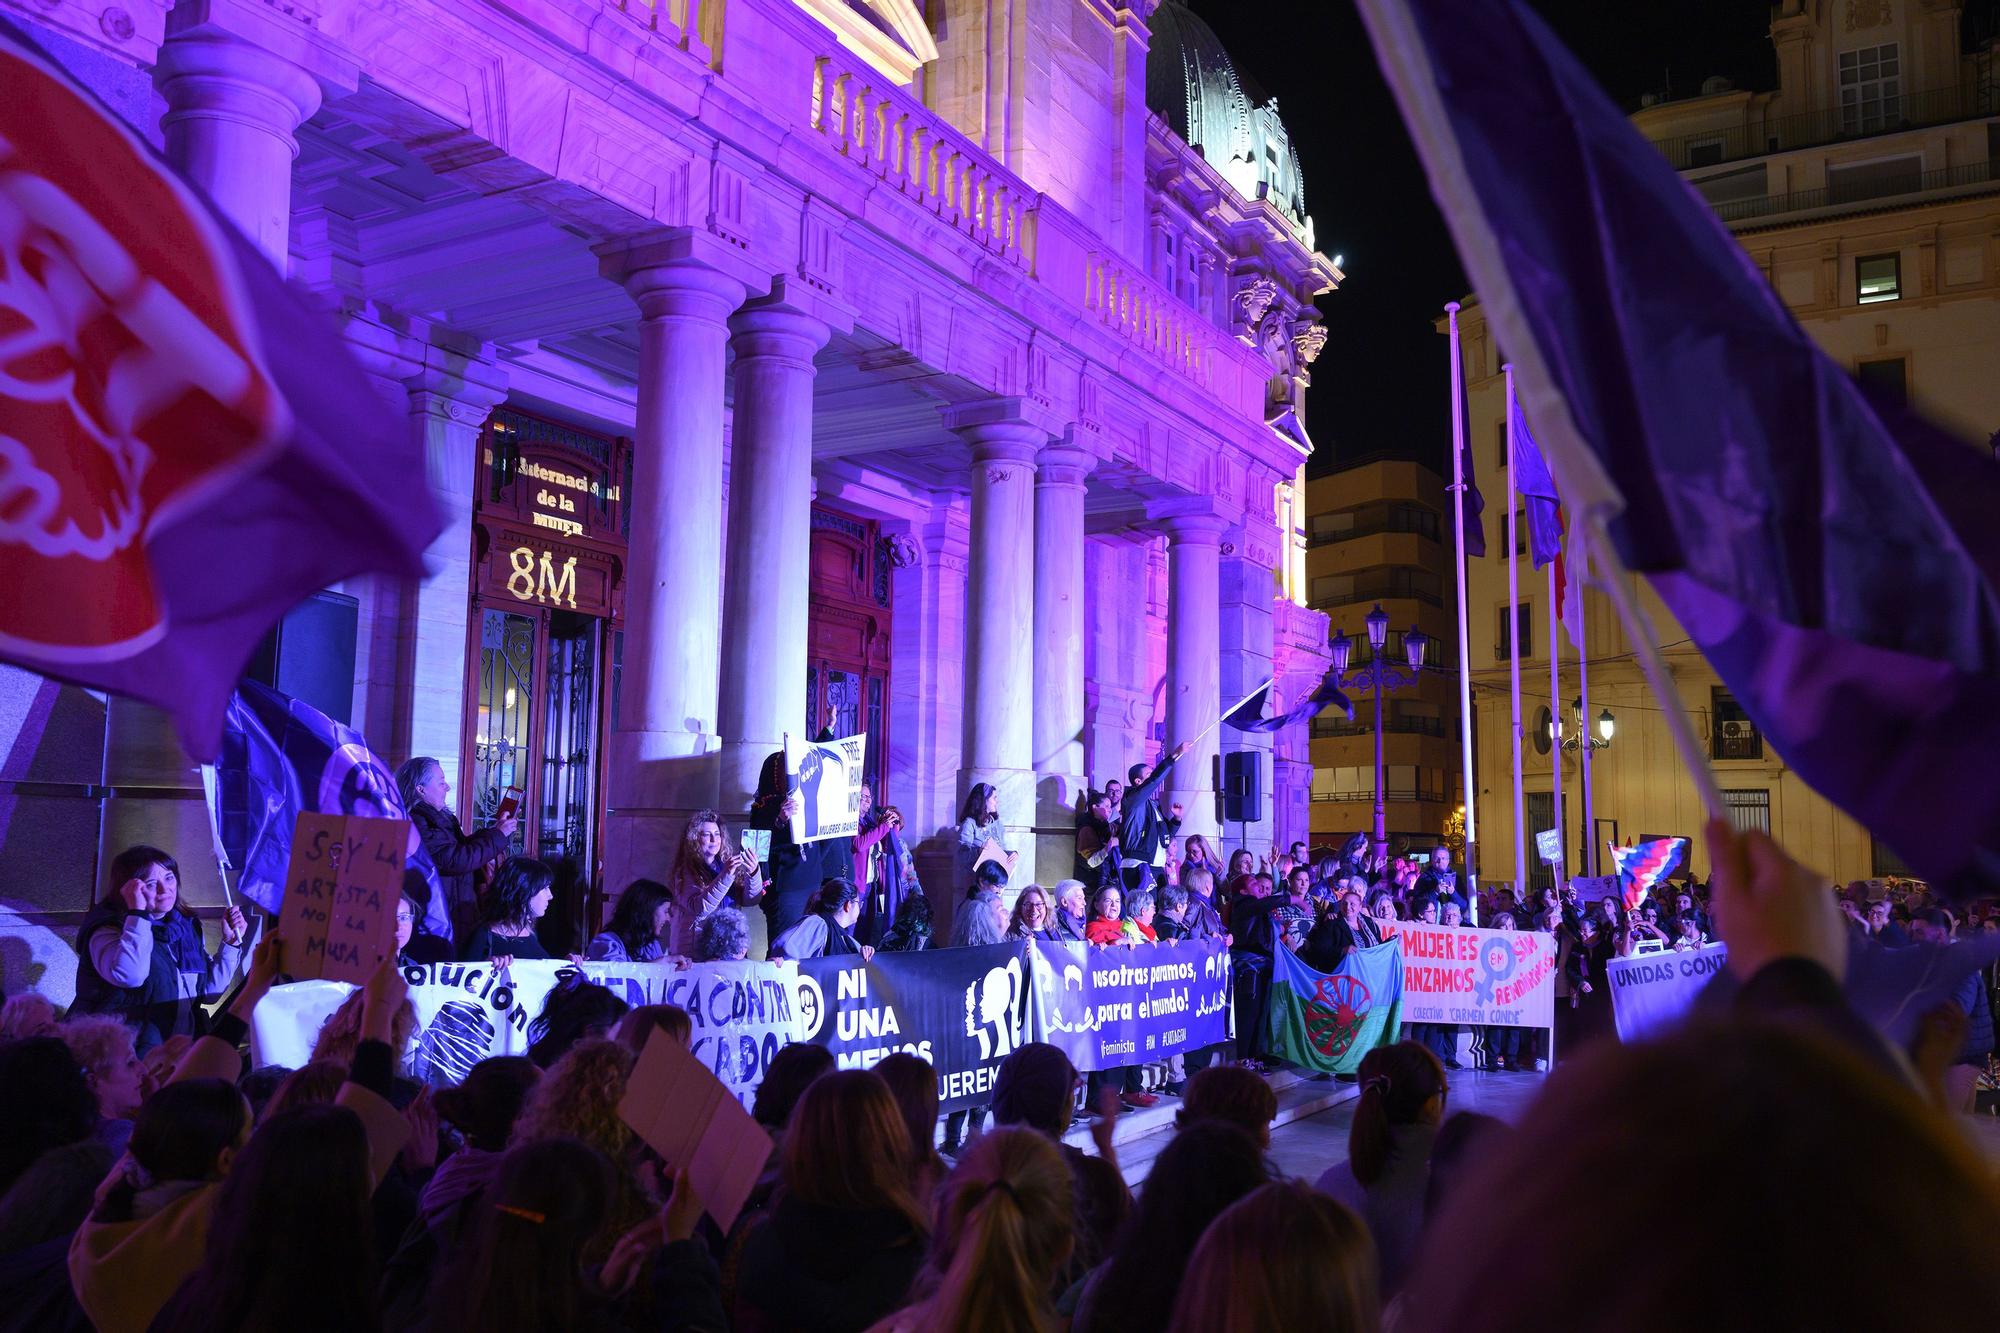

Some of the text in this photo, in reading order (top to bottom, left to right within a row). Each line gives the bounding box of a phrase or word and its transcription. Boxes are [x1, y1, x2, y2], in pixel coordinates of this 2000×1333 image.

[537, 489, 575, 513] de la
[506, 547, 578, 609] 8M
[305, 831, 398, 873] SOY LA
[301, 907, 366, 932] NO LA
[306, 936, 360, 967] MUSA
[1403, 930, 1479, 961] MUJERES
[837, 968, 867, 1000] NI
[1150, 962, 1196, 990] paramos,
[1404, 966, 1475, 993] ANZAMOS
[1615, 962, 1674, 987] UNIDAS
[837, 1005, 900, 1041] UNA
[1098, 987, 1190, 1029] para el mundo!
